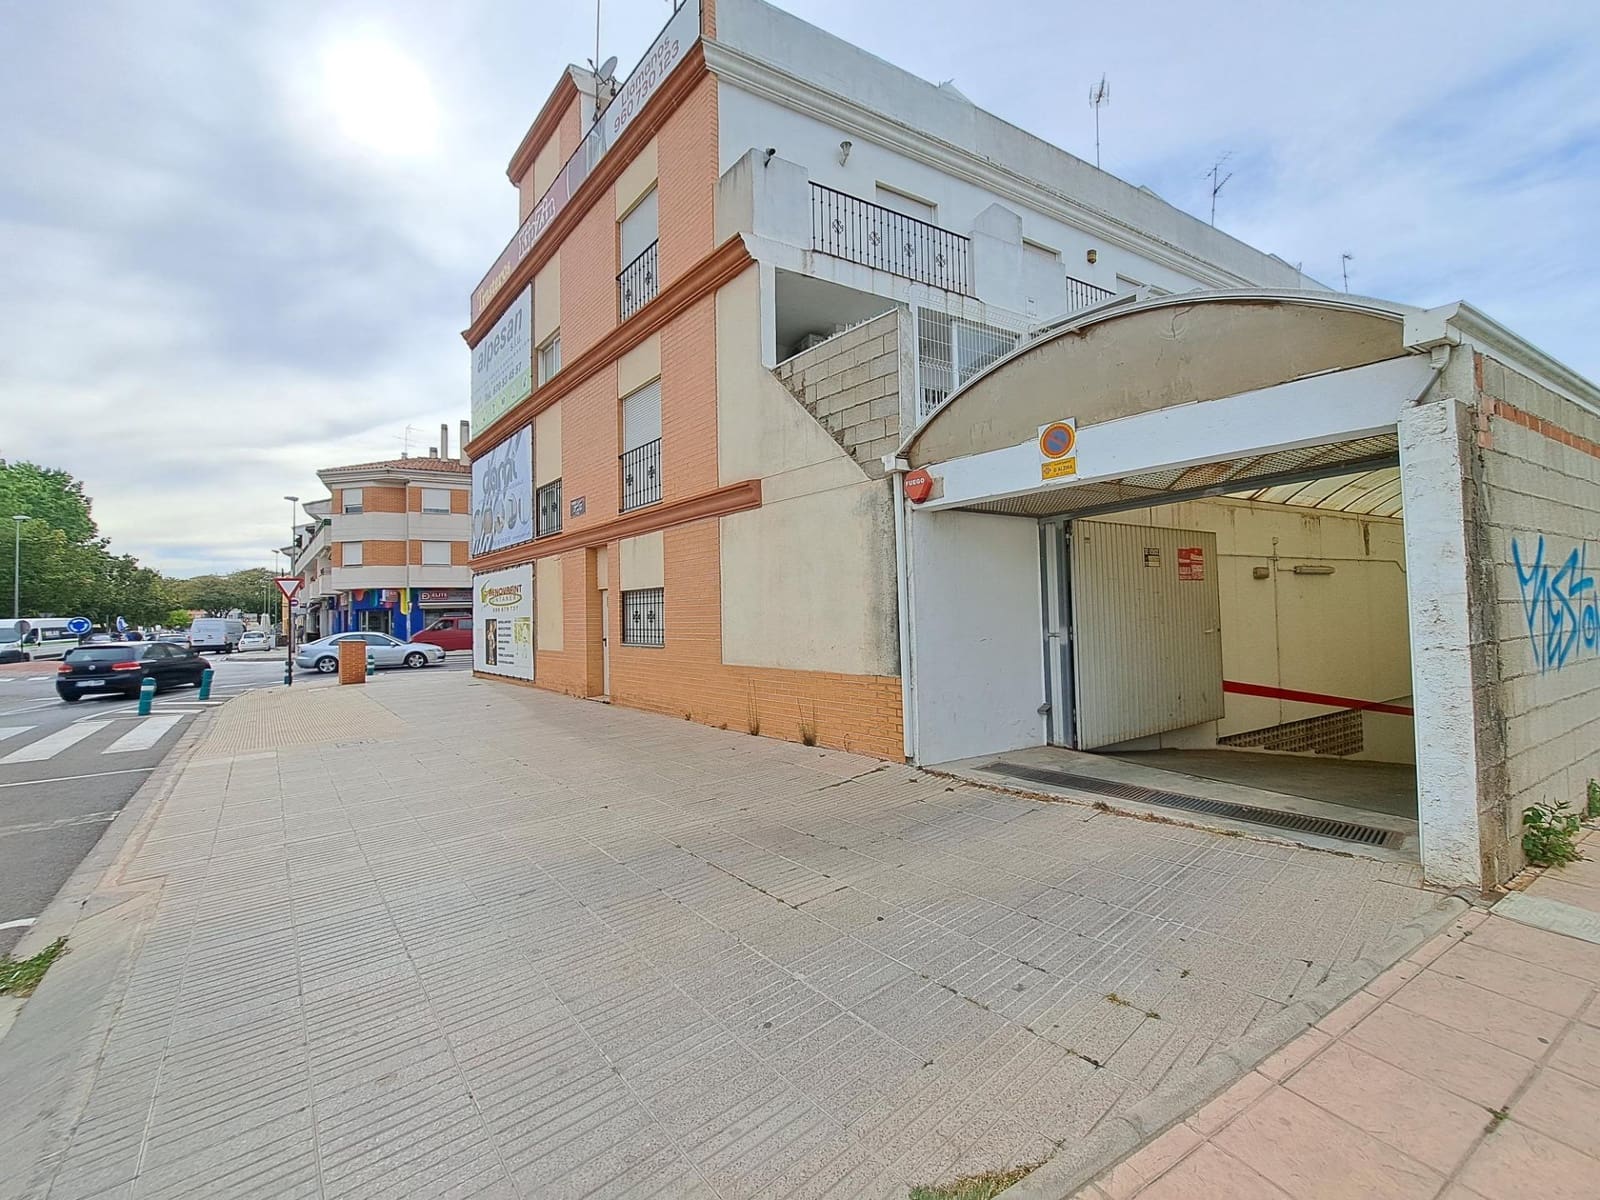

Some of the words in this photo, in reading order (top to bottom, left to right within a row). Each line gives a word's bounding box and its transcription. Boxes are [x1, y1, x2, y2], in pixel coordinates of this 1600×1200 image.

[614, 99, 634, 133] 960
[636, 70, 656, 106] 730
[659, 39, 679, 77] 123
[477, 308, 522, 374] alpesan
[905, 477, 925, 488] FUEGO
